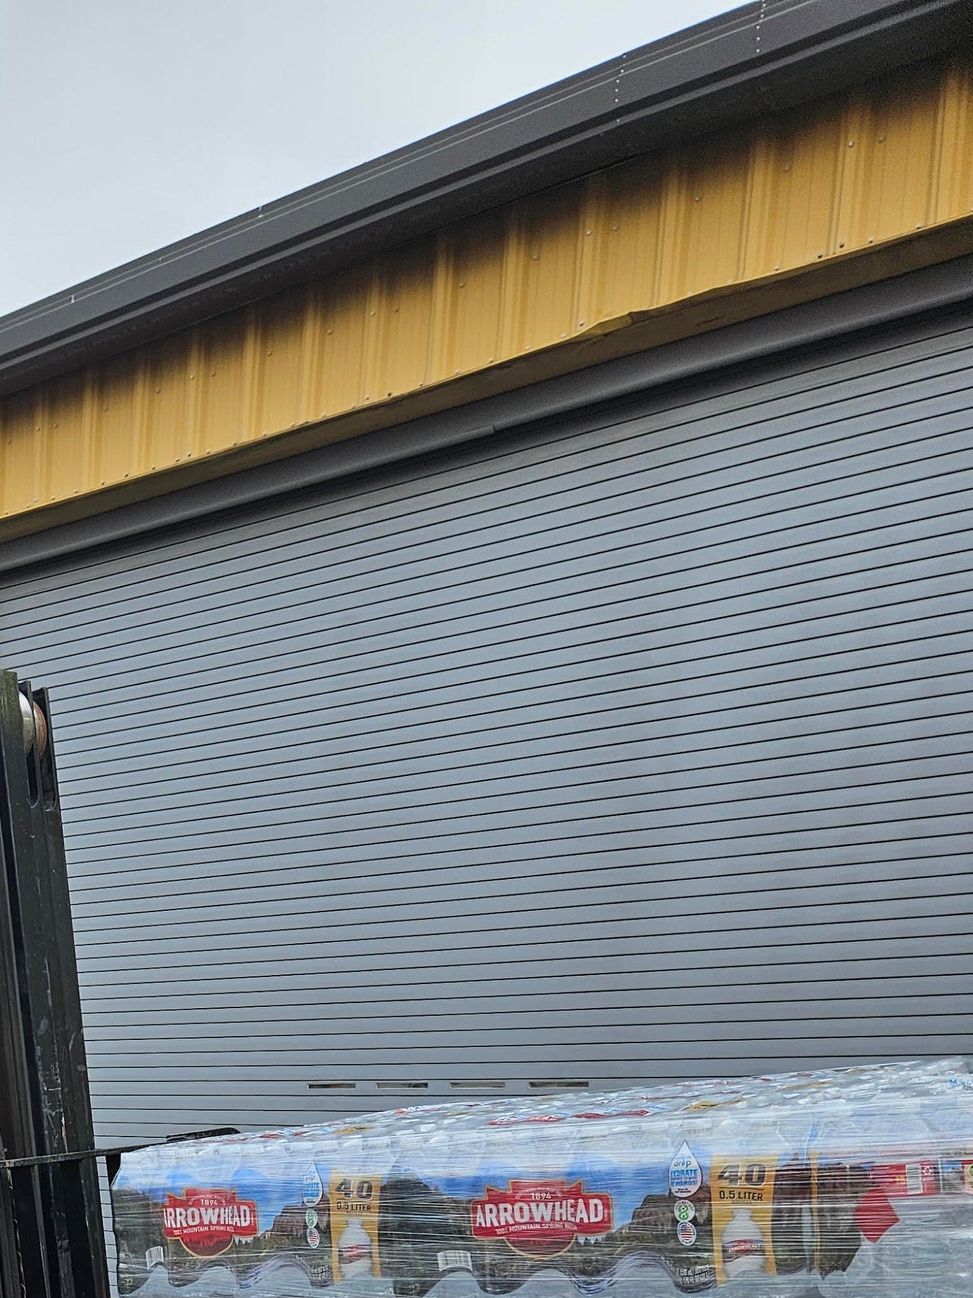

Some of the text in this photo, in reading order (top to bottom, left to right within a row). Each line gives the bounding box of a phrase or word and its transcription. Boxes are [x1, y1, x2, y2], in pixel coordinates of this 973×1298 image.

[717, 1164, 767, 1186] 40
[335, 1179, 373, 1199] 40
[719, 1190, 763, 1201] 0.5 LITER
[351, 1203, 371, 1212] LITER
[476, 1199, 603, 1227] ARROWHEAD
